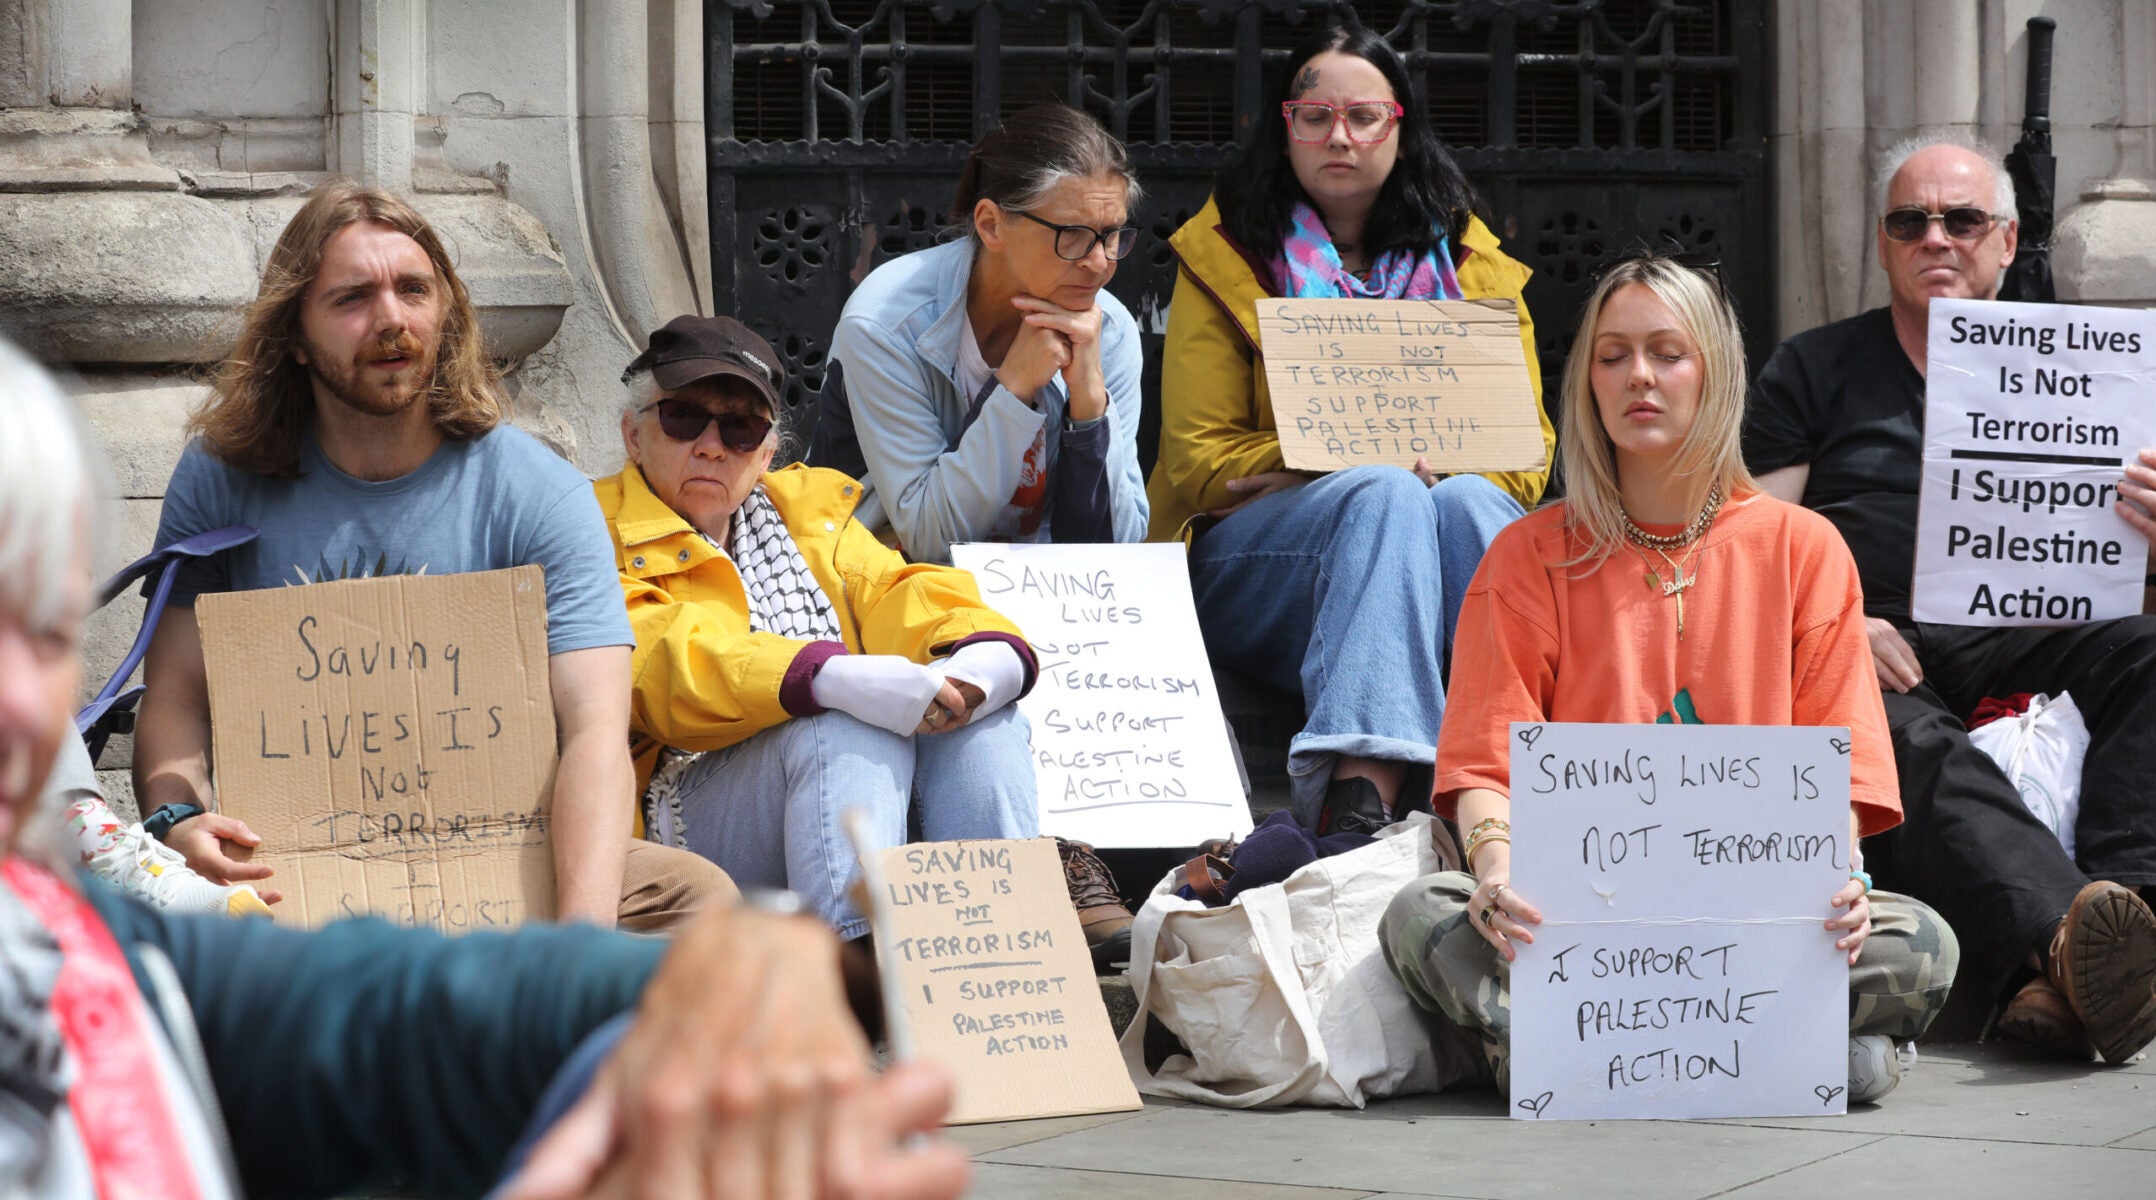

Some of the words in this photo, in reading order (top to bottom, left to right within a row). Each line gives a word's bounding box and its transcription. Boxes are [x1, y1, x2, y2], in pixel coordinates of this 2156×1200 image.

[1277, 305, 1380, 335] SAVING
[1396, 310, 1469, 338] LIVES
[1949, 316, 2056, 355] Saving
[2066, 322, 2142, 354] Lives
[1318, 342, 1344, 358] IS
[1400, 345, 1446, 359] NOT
[1286, 365, 1460, 386] TERRORISM
[1999, 366, 2023, 394] Is
[2034, 368, 2092, 398] Not
[1306, 396, 1442, 415] SUPPORT
[1296, 416, 1483, 438] PALESTINE
[1966, 411, 2120, 446] Terrorism
[1326, 434, 1463, 456] ACTION
[1950, 468, 1961, 500] I
[1947, 525, 2122, 565] Palestine
[983, 559, 1116, 600] SAVING
[1061, 603, 1142, 624] LIVES
[1968, 583, 2093, 620] Action
[296, 615, 461, 697] Saving
[1040, 661, 1200, 697] TERRORISM
[436, 705, 504, 751] IS
[1045, 709, 1184, 733] SUPPORT
[1680, 754, 1762, 789] LIVES
[1792, 764, 1820, 801] IS
[312, 806, 546, 845] TERRORISM
[906, 847, 1013, 875] SAVING
[1682, 828, 1846, 870] TERRORISM
[888, 879, 970, 907] LIVES
[991, 879, 1012, 895] IS
[955, 904, 991, 922] NOT
[896, 929, 1053, 962] TERRORISM
[1591, 943, 1738, 981] SUPPORT
[922, 983, 934, 1005] I
[959, 976, 1067, 1000] SUPPORT
[952, 1009, 1066, 1036] PALESTINE
[1576, 988, 1779, 1042] PALESTINE
[986, 1034, 1069, 1056] ACTION
[1607, 1040, 1741, 1090] ACTION
